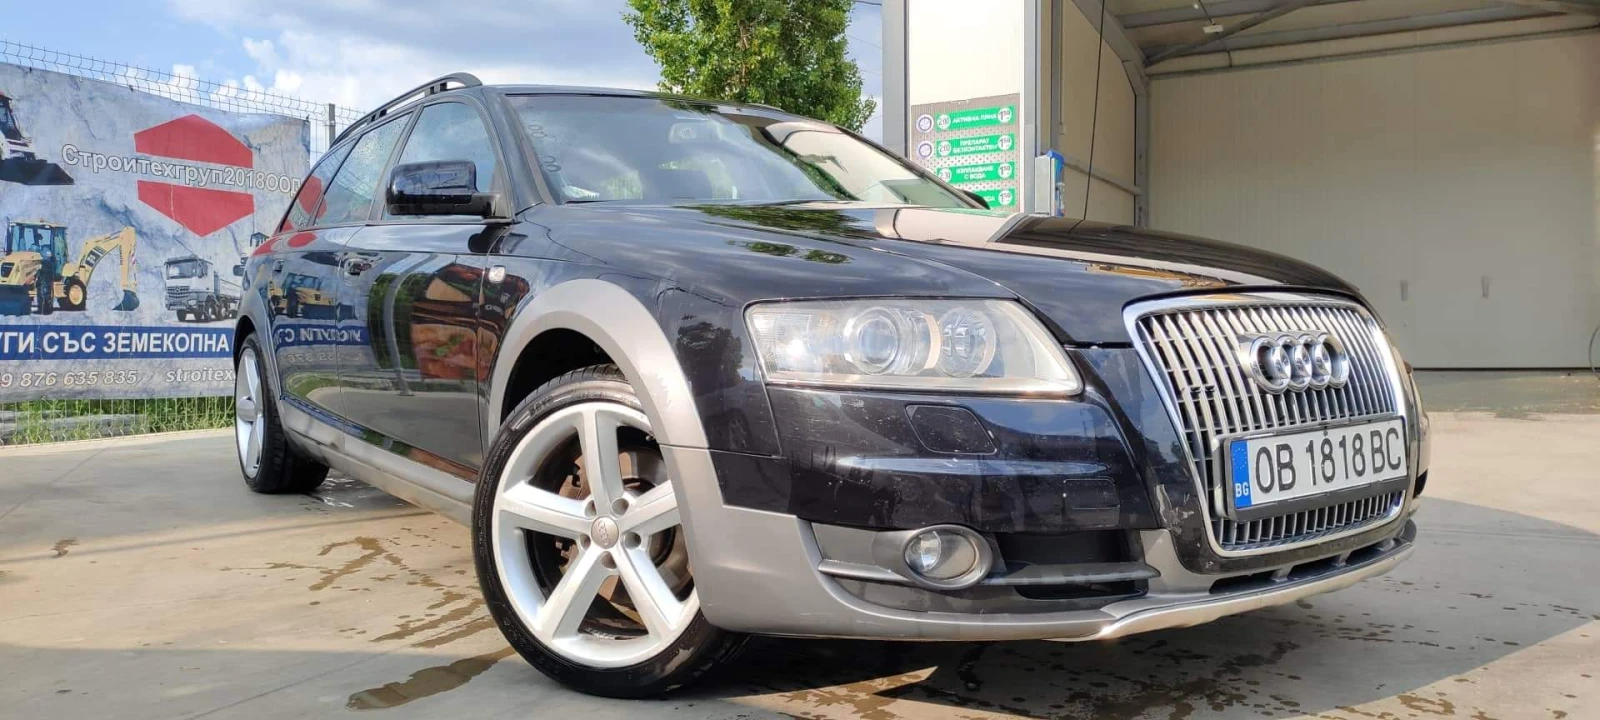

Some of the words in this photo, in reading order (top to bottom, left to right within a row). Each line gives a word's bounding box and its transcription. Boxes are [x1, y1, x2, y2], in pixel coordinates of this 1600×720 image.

[0, 331, 35, 353] ГИ
[43, 331, 96, 353] СЪС
[103, 331, 230, 353] ЗЕМЕКОПНА
[20, 372, 58, 388] 876
[63, 370, 100, 386] 635
[104, 369, 138, 385] 835
[165, 366, 236, 382] stroitex
[1255, 443, 1297, 494] OB
[1305, 433, 1366, 486] 1818
[1370, 427, 1401, 475] BC
[1235, 482, 1249, 498] BG
